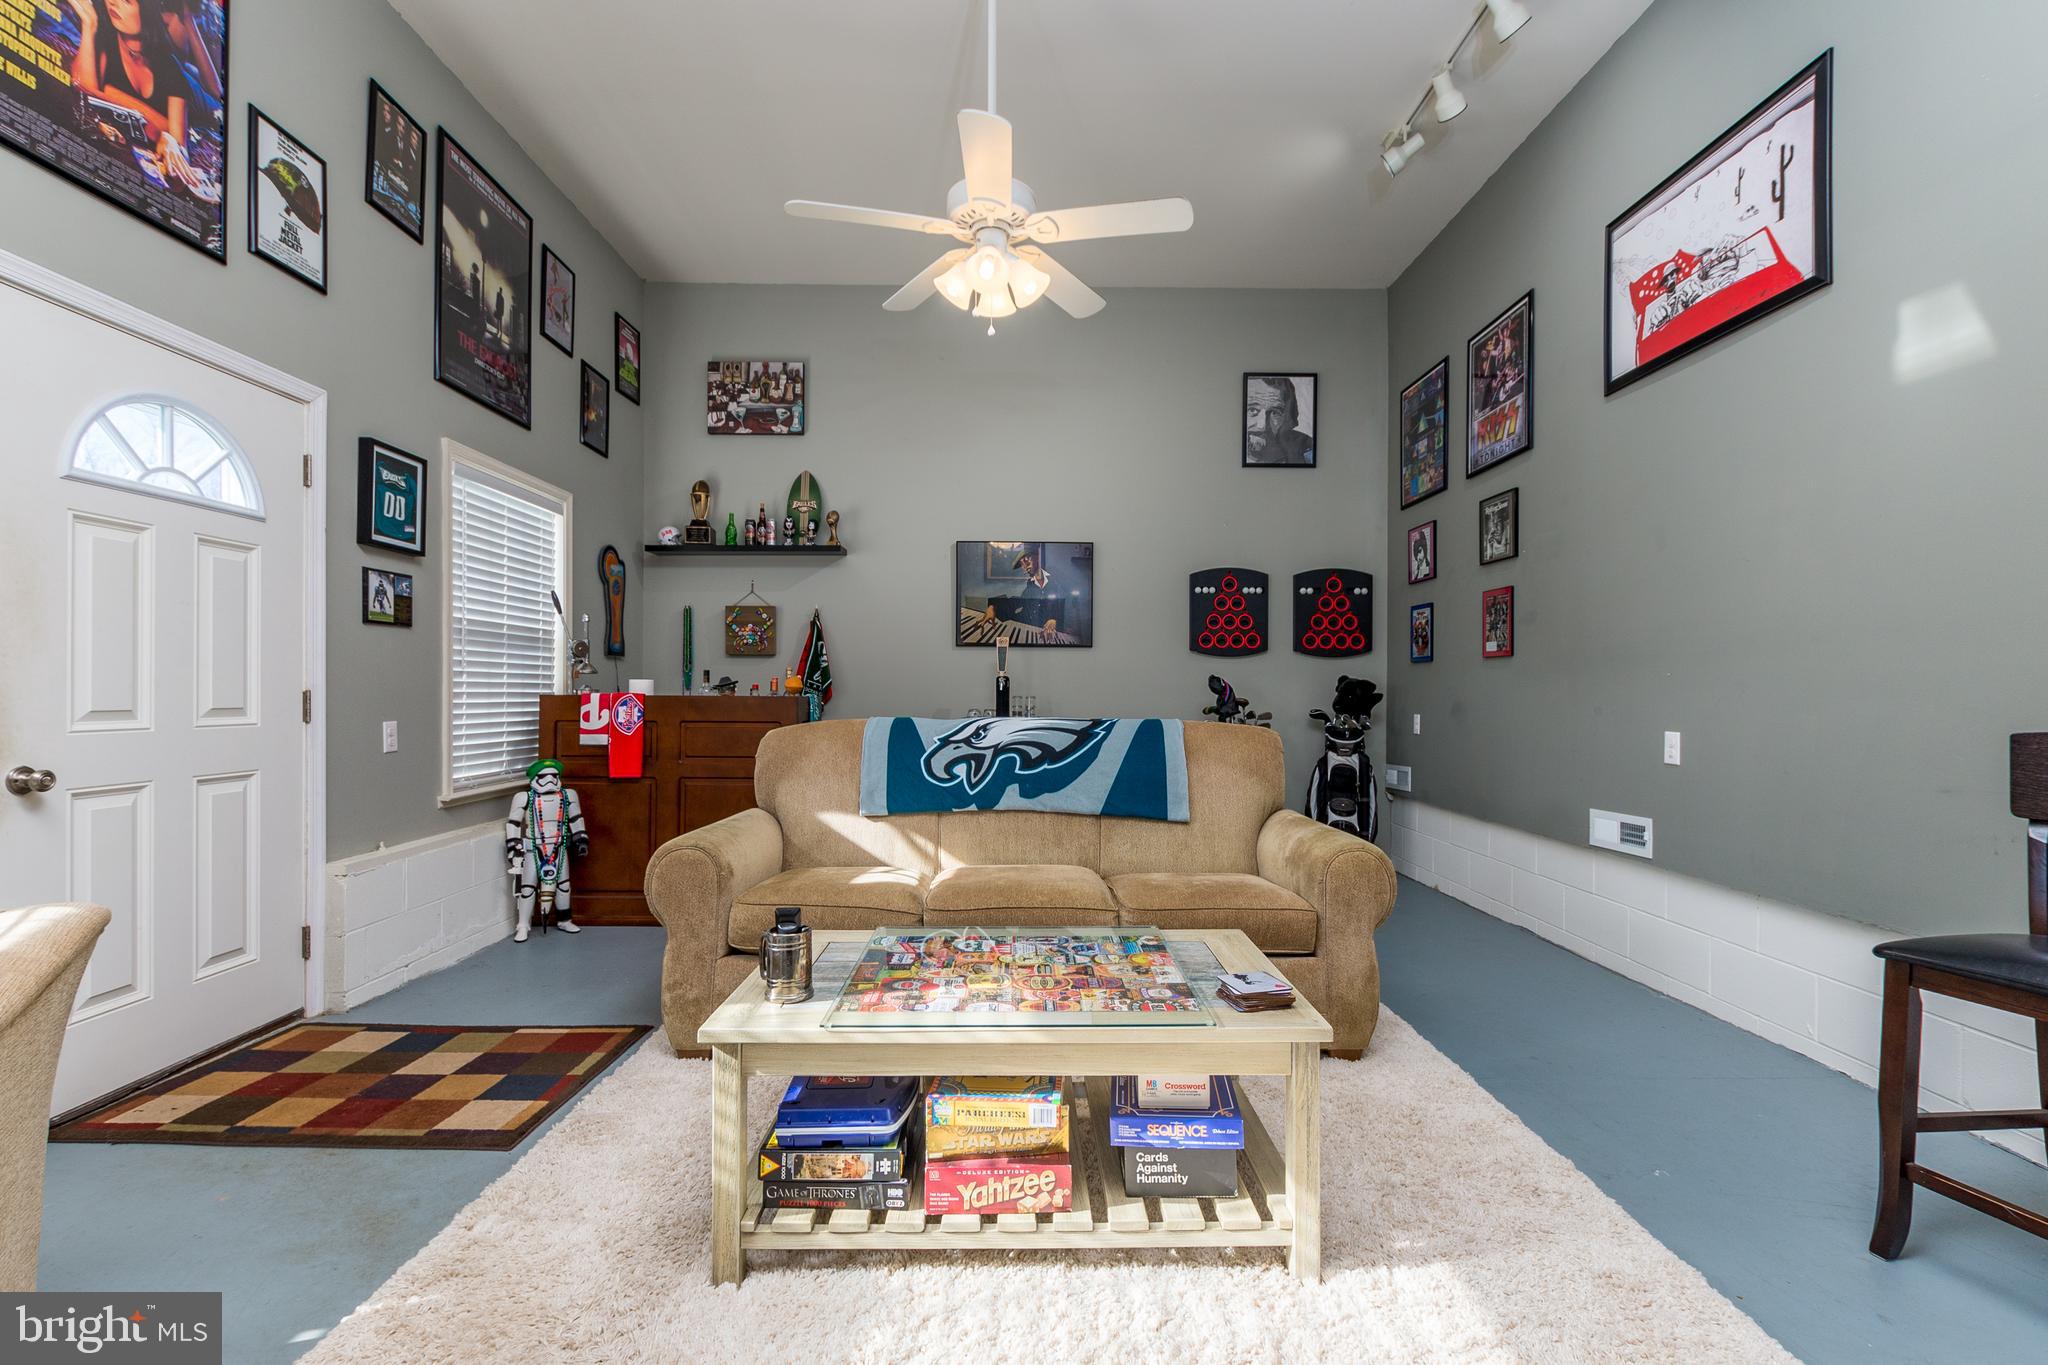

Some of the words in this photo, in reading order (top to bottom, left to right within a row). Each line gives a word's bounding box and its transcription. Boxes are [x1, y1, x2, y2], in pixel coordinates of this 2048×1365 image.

[6, 59, 37, 90] WILLIS
[280, 226, 302, 247] METAL
[283, 220, 299, 236] FULL
[278, 234, 303, 255] JACKET
[457, 329, 478, 356] THE
[1477, 400, 1521, 451] KISS
[383, 491, 406, 521] 00
[1164, 1082, 1206, 1091] Crossword
[1146, 1124, 1209, 1137] SEQUENCE
[943, 1135, 996, 1150] STAR
[997, 1131, 1051, 1147] WARS
[1136, 1152, 1169, 1163] Cards
[1136, 1163, 1178, 1175] Against
[1136, 1173, 1189, 1185] Humanity
[766, 1186, 800, 1199] GAME
[807, 1187, 857, 1199] THRONES
[957, 1169, 1056, 1211] Yahtzee
